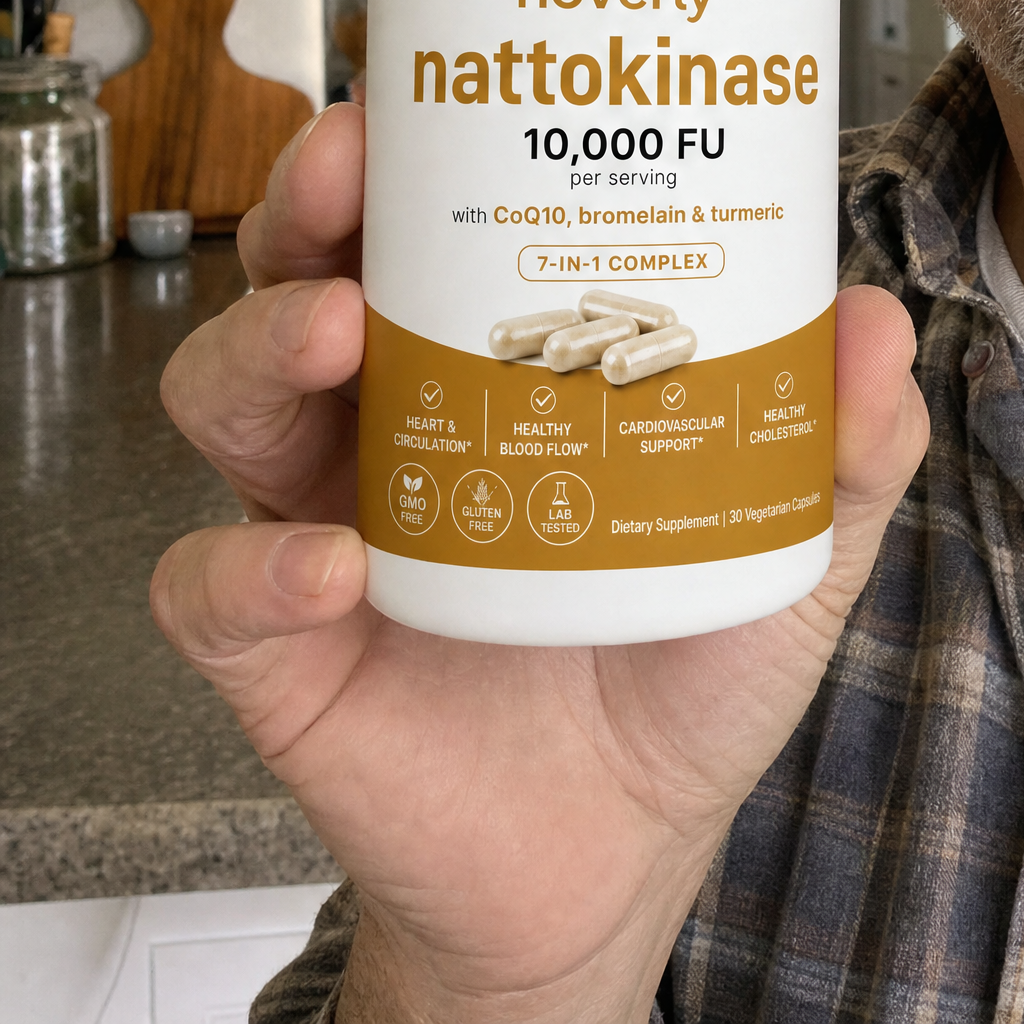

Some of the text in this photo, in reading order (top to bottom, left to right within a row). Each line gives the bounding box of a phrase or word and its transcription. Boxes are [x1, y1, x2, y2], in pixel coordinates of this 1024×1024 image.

[413, 36, 819, 106] nattokinase
[524, 128, 725, 166] 10,000 FU
[570, 169, 677, 189] per serving
[452, 203, 784, 228] with CoQ10, bromelain & turmeric
[537, 253, 708, 272] 7-IN-1 COMPLEX
[763, 403, 806, 423] HEALTHY
[406, 415, 456, 433] HEART &
[513, 422, 572, 437] HEALTHY
[619, 416, 725, 435] CARDIOVASCULAR
[500, 442, 543, 456] BLOOD
[399, 494, 427, 511] GMO
[401, 511, 423, 525] FREE
[462, 505, 502, 519] GLUTEN
[548, 508, 572, 520] LAB
[611, 491, 821, 536] Dietary Supplement 30 Vegetarian Capsules
[469, 520, 494, 532] FREE
[541, 521, 580, 533] TESTED
